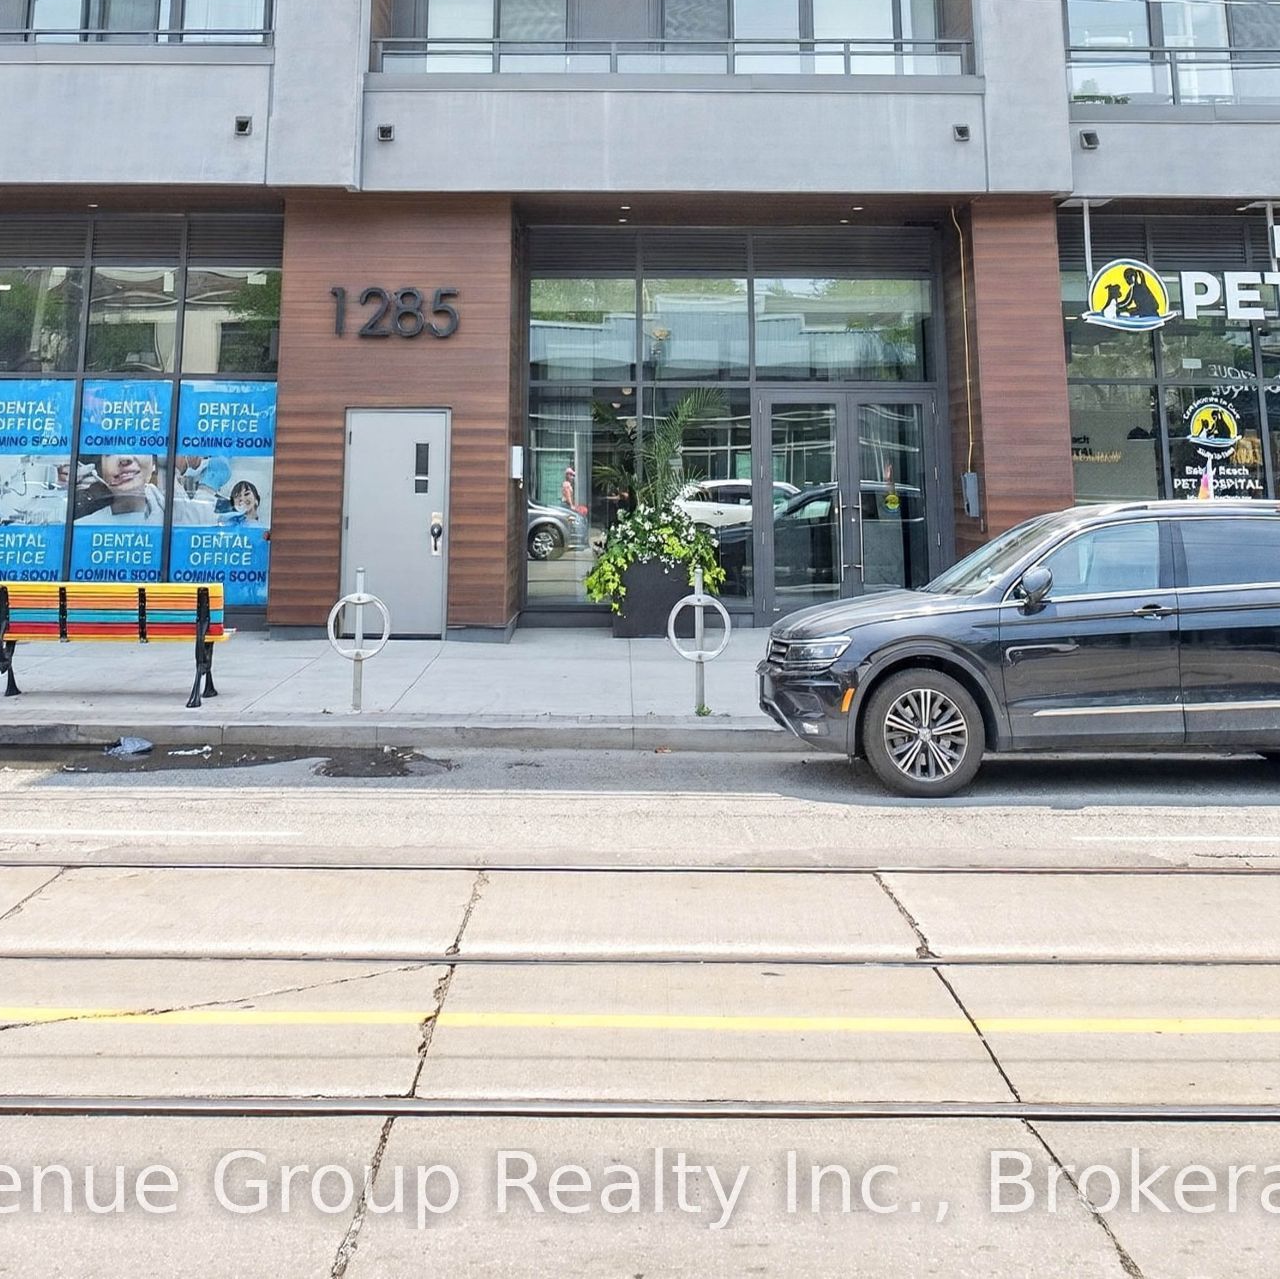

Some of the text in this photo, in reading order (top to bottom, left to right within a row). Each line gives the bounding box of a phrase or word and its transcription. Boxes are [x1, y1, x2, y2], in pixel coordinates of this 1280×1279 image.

[330, 287, 461, 338] 1285
[102, 401, 162, 414] DENTAL
[199, 403, 258, 416] DENTAL
[101, 418, 161, 431] OFFICE
[198, 419, 258, 432] OFFICE
[31, 436, 68, 447] SOON
[84, 436, 136, 447] COMING
[182, 437, 272, 448] COMING SOON
[1173, 478, 1264, 490] PET OSPITAL
[92, 534, 153, 547] DENTAL
[191, 535, 252, 548] DENTAL
[91, 551, 151, 564] OFFICE
[190, 552, 252, 565] OFFICE
[21, 569, 59, 581] SOON
[75, 569, 127, 581] COMING
[174, 570, 266, 582] COMING SOON
